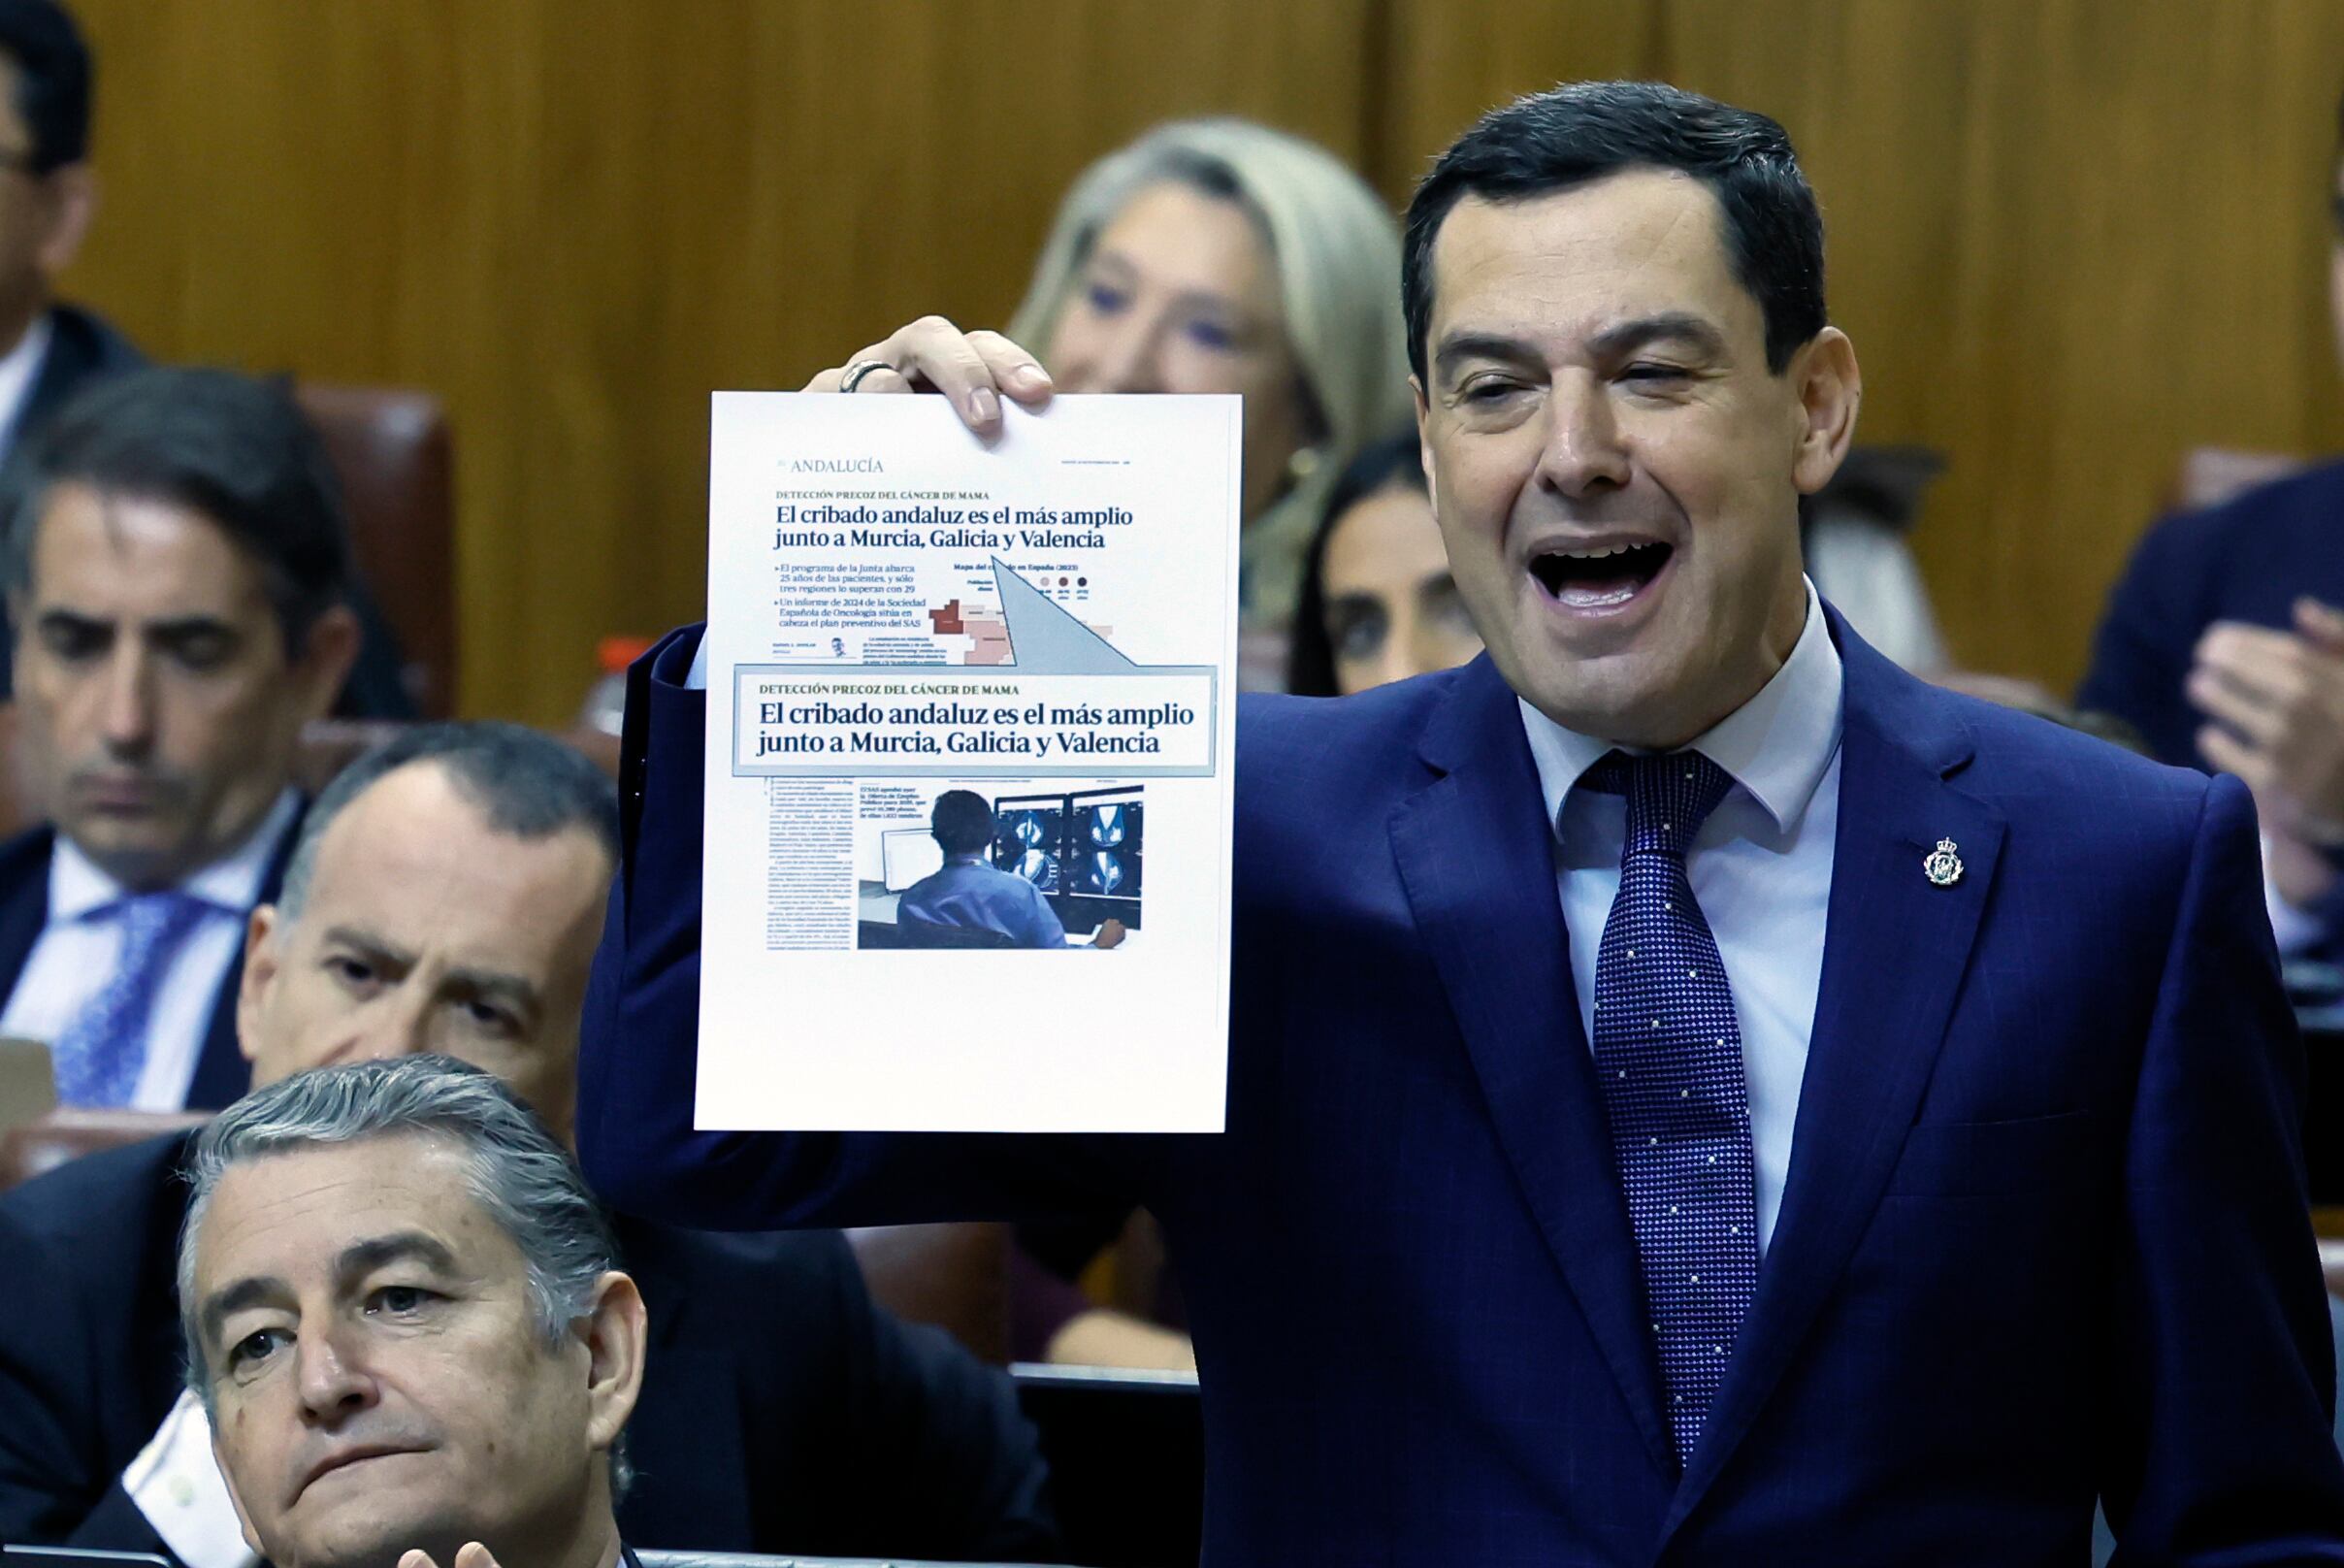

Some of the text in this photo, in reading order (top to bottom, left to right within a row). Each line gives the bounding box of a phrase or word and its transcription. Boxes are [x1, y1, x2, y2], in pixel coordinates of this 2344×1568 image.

[791, 457, 884, 473] ANDALUCÍA
[776, 489, 833, 500] DETECCIÓN
[900, 490, 940, 500] CÁNCER
[776, 506, 1133, 528] El cribado andaluz es el más amplio
[773, 528, 1105, 551] junto a Murcia, Galicia y Valencia
[759, 683, 1019, 695] DETECCIÓN PRECOZ DEL CÁNCER DE MAMA
[760, 702, 1194, 729] El cribado andaluz es el más amplio
[756, 731, 1160, 757] junto a Murcia, Galicia y Valencia
